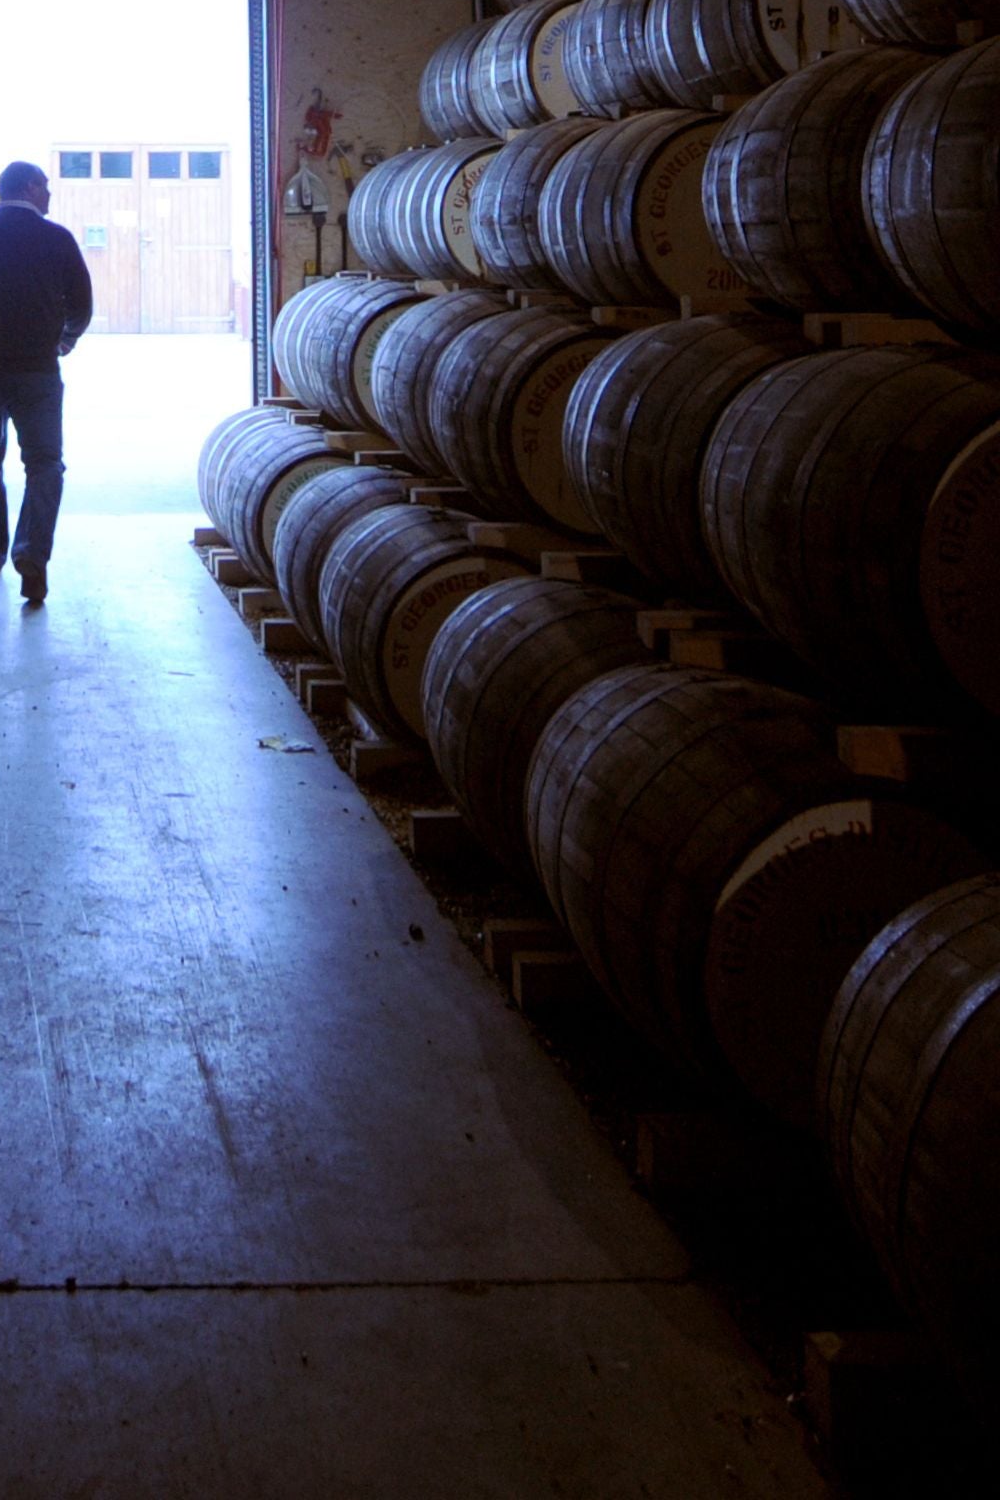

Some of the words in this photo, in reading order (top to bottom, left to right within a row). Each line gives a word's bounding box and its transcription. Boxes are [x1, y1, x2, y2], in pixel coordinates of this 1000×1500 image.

[767, 5, 787, 31] ST
[451, 215, 465, 236] ST
[707, 268, 745, 291] 200
[525, 350, 597, 418] GEORGE
[401, 571, 490, 632] GEORGES
[393, 639, 410, 669] ST
